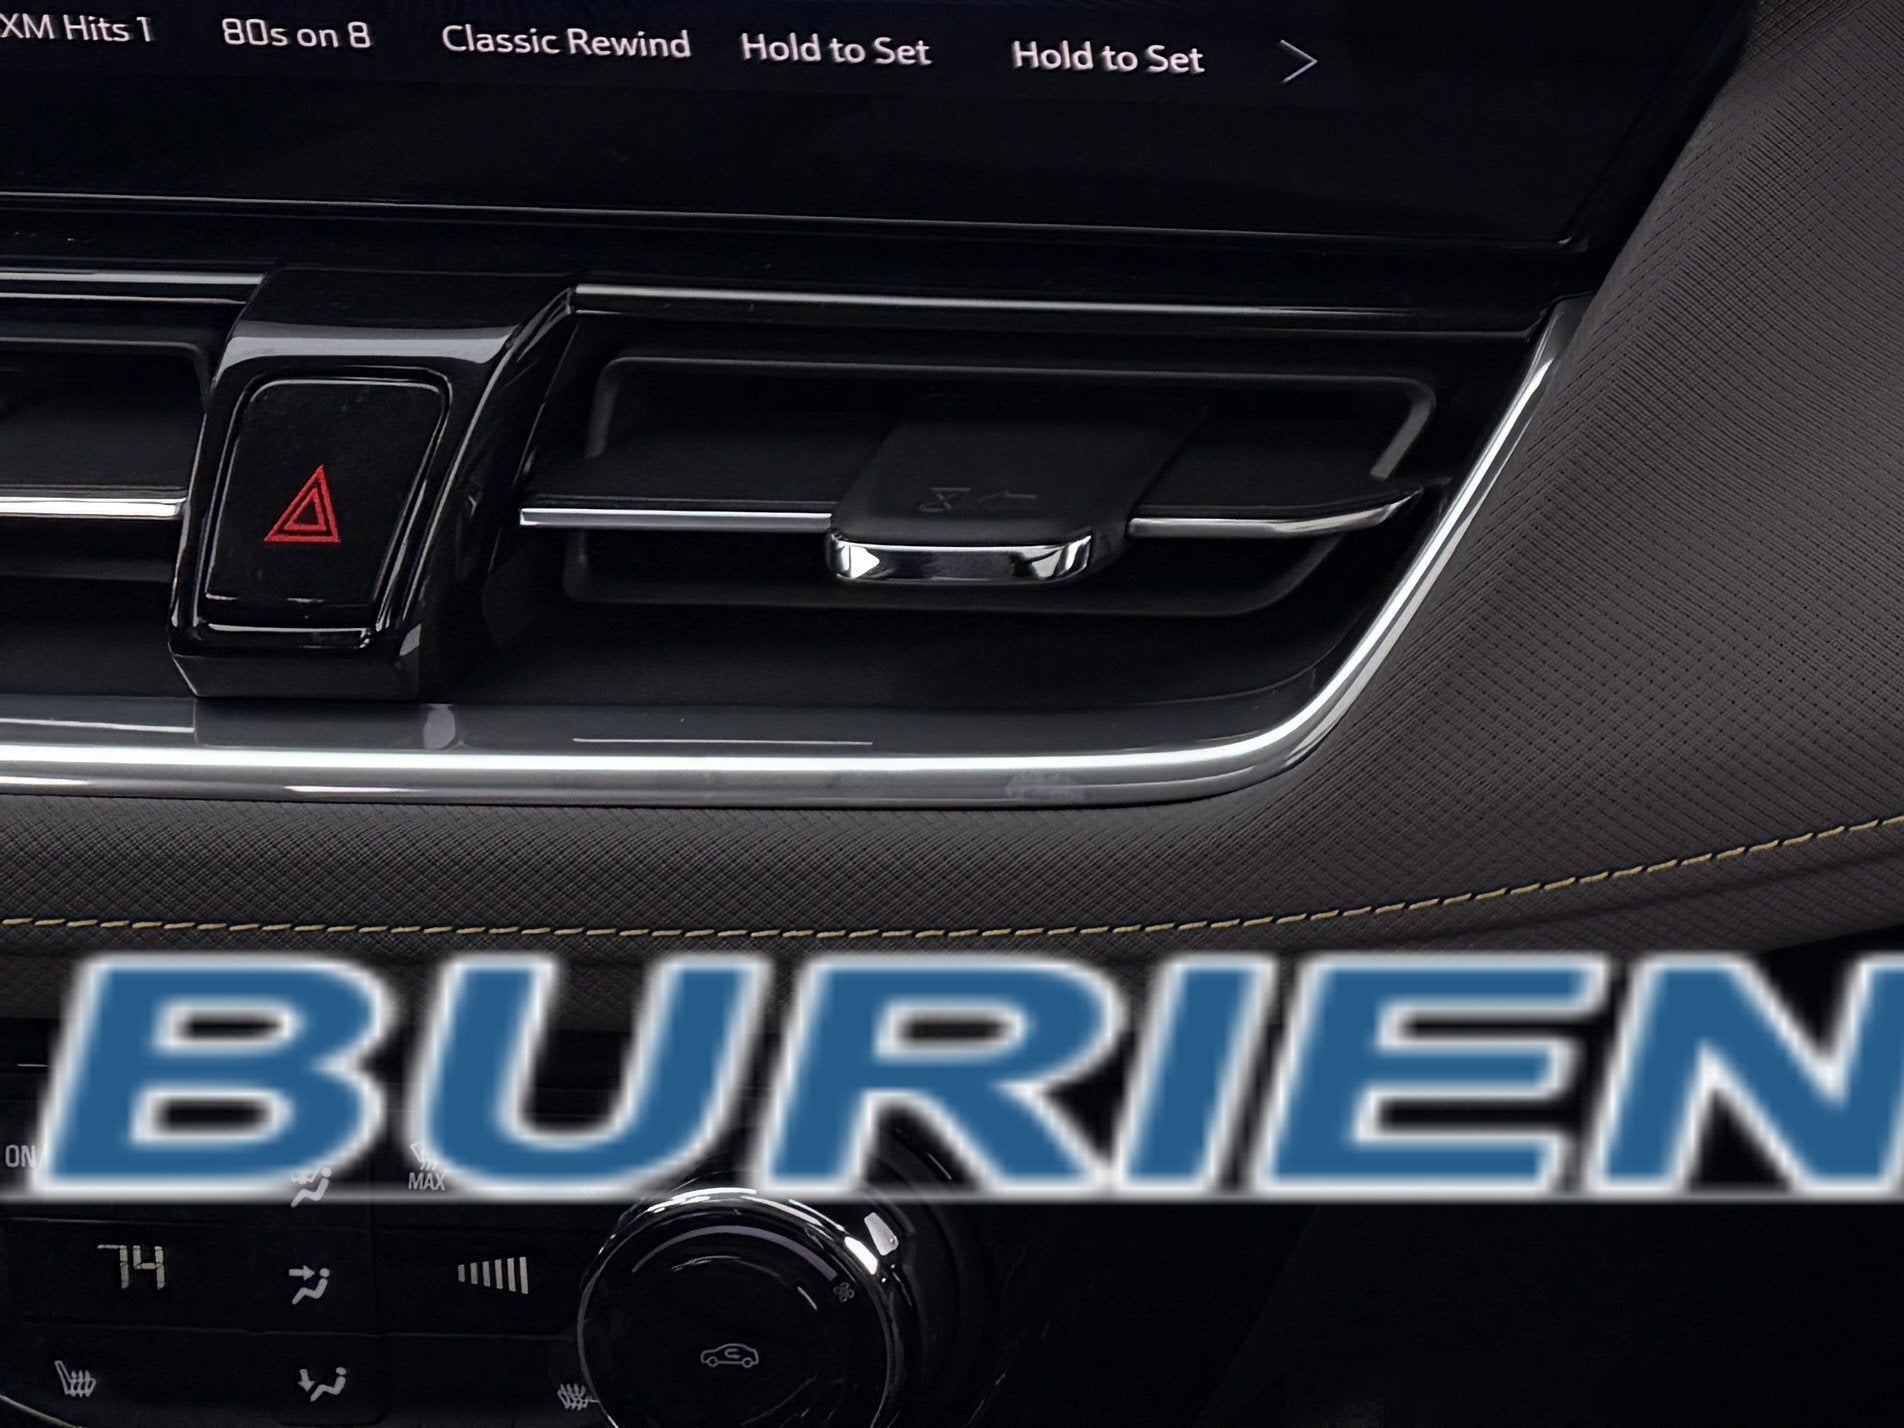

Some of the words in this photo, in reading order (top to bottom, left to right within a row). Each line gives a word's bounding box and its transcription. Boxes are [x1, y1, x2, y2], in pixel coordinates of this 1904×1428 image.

[64, 15, 129, 42] Hits
[136, 17, 153, 41] 1
[221, 18, 289, 47] 80s
[297, 25, 339, 47] on
[348, 22, 373, 48] 8
[441, 24, 558, 55] Classic
[568, 29, 692, 58] Rewind
[740, 32, 822, 62] Hold
[829, 39, 866, 64] to
[874, 36, 932, 66] Set
[1012, 41, 1094, 70] Hold
[1101, 47, 1139, 73] to
[1145, 45, 1206, 74] Set
[408, 1172, 446, 1191] MAX
[98, 1245, 166, 1289] 74
